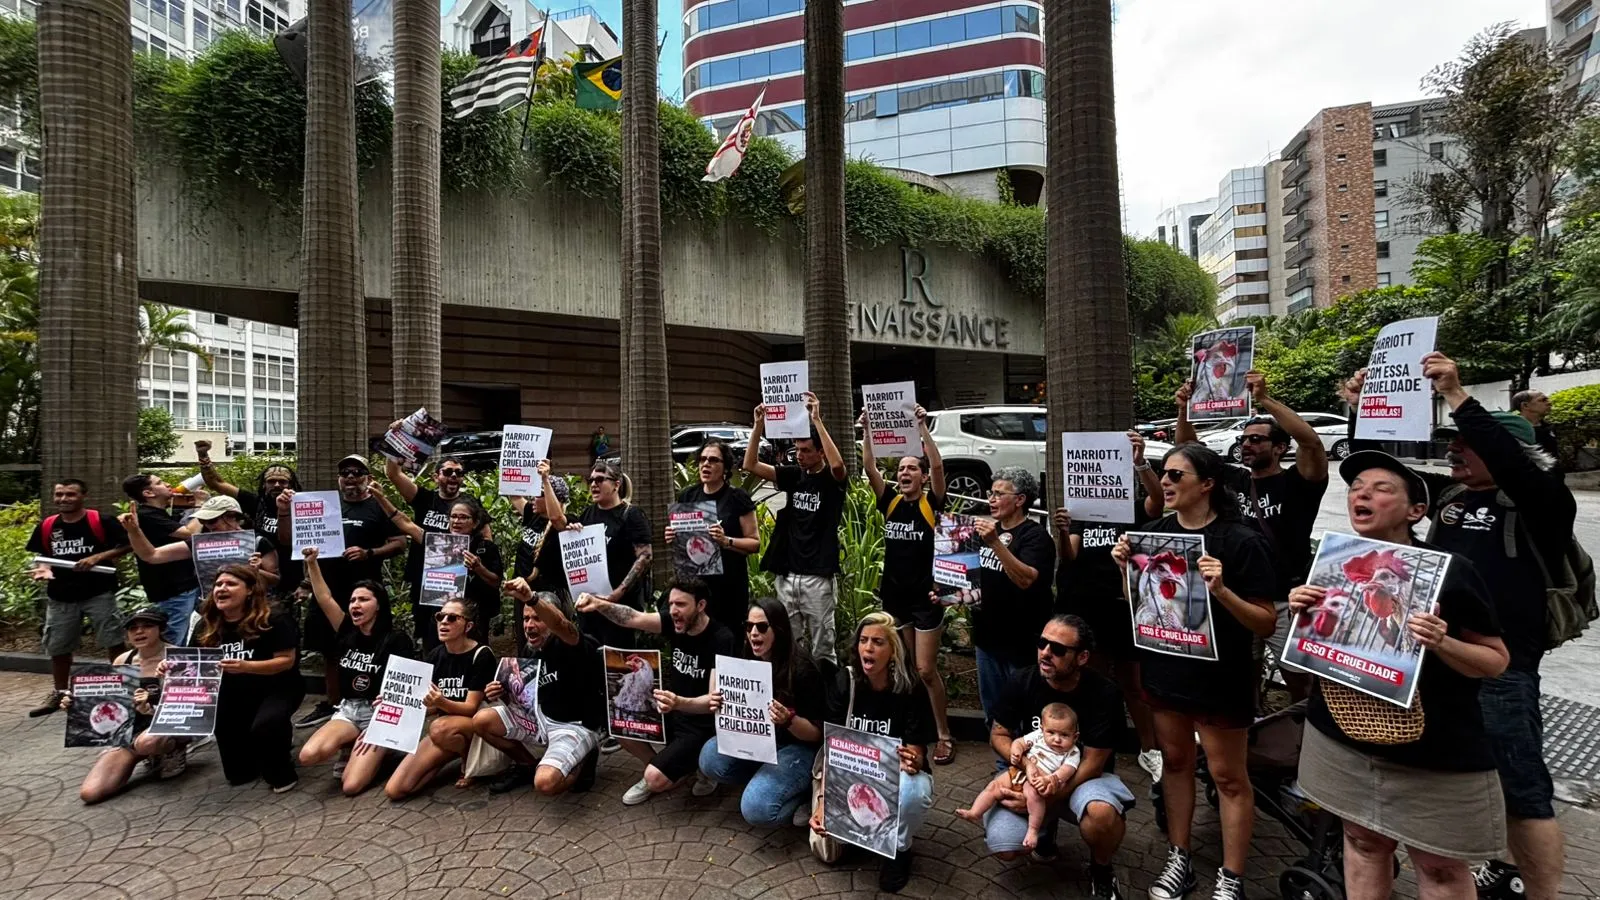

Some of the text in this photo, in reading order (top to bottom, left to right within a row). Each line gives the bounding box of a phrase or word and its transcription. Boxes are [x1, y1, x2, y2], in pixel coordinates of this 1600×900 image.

[900, 246, 944, 308] R
[848, 301, 1010, 347] ENAISSANCE
[763, 374, 798, 384] MARRIOTT
[1366, 364, 1410, 380] COM ESSA
[764, 385, 790, 394] APOIA A
[1364, 378, 1422, 394] CRUELDADE
[765, 394, 804, 404] CRUELDADE
[866, 391, 904, 402] MARRIOTT
[1362, 398, 1374, 406] PELO
[867, 402, 886, 411] PARE
[1211, 400, 1242, 408] CRUELDADE
[869, 411, 905, 421] COM ESSA
[1371, 407, 1401, 416] GAIOLAS!
[870, 420, 914, 430] CRUELDADE
[505, 433, 541, 442] MARRIOTT
[1067, 450, 1122, 461] MARRIOTT,
[1067, 462, 1102, 473] PONHA
[1068, 474, 1122, 486] FIM NESSA
[1068, 486, 1129, 499] CRUELDADE
[562, 537, 595, 552] MARRIOTT
[1083, 536, 1121, 548] EQUAL
[564, 550, 582, 560] APOIA
[565, 554, 602, 570] CRUELDADE
[1140, 626, 1203, 643] ISSO É CRUELDADE
[345, 649, 375, 663] nimal
[1302, 640, 1325, 656] ISSO
[1327, 649, 1334, 658] É
[1336, 652, 1399, 682] CRUELDADE
[340, 657, 381, 674] QUALITY
[386, 670, 423, 686] MARRIOTT
[719, 674, 764, 694] MARRIOTT,
[384, 681, 412, 696] APOIA A
[383, 692, 423, 710] CRUELDADE
[720, 689, 746, 704] PONHA
[381, 704, 396, 714] CHEGA
[720, 703, 765, 720] FIM NESSA
[719, 716, 771, 736] CRUELDADE
[831, 738, 878, 759] RENAISSANCE,
[844, 754, 856, 762] ovos
[858, 756, 869, 766] vêm
[870, 760, 878, 768] do
[830, 759, 852, 769] sistema
[861, 767, 884, 779] gaiolas?
